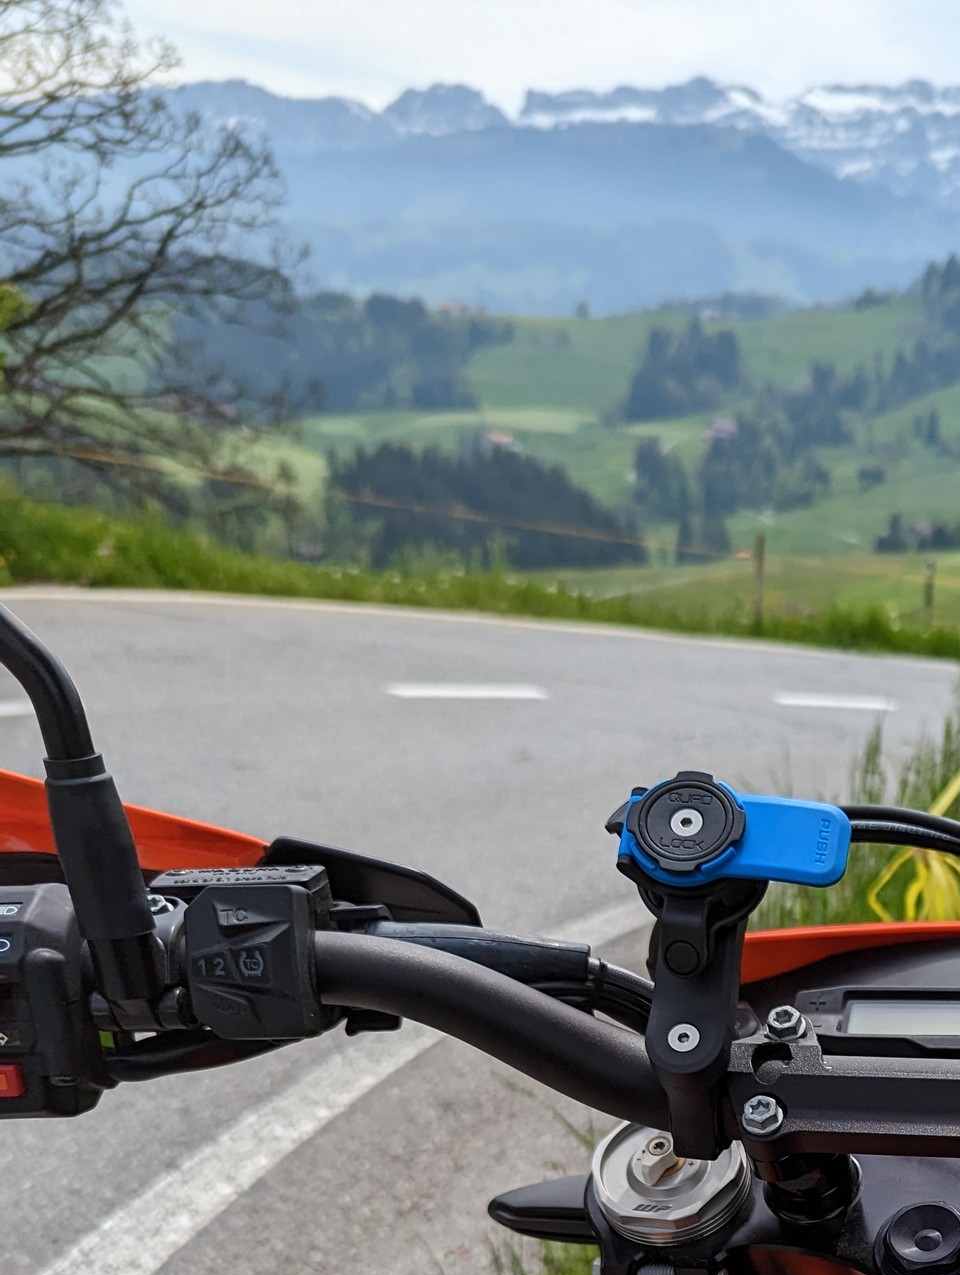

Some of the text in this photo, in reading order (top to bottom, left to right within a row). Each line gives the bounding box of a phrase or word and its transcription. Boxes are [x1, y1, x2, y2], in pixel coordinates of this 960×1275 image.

[668, 792, 713, 806] QUAD
[659, 836, 705, 851] LOCK
[814, 818, 832, 864] PUSH
[219, 906, 249, 926] TC
[197, 958, 226, 976] 1 2
[632, 1203, 672, 1213] WP
